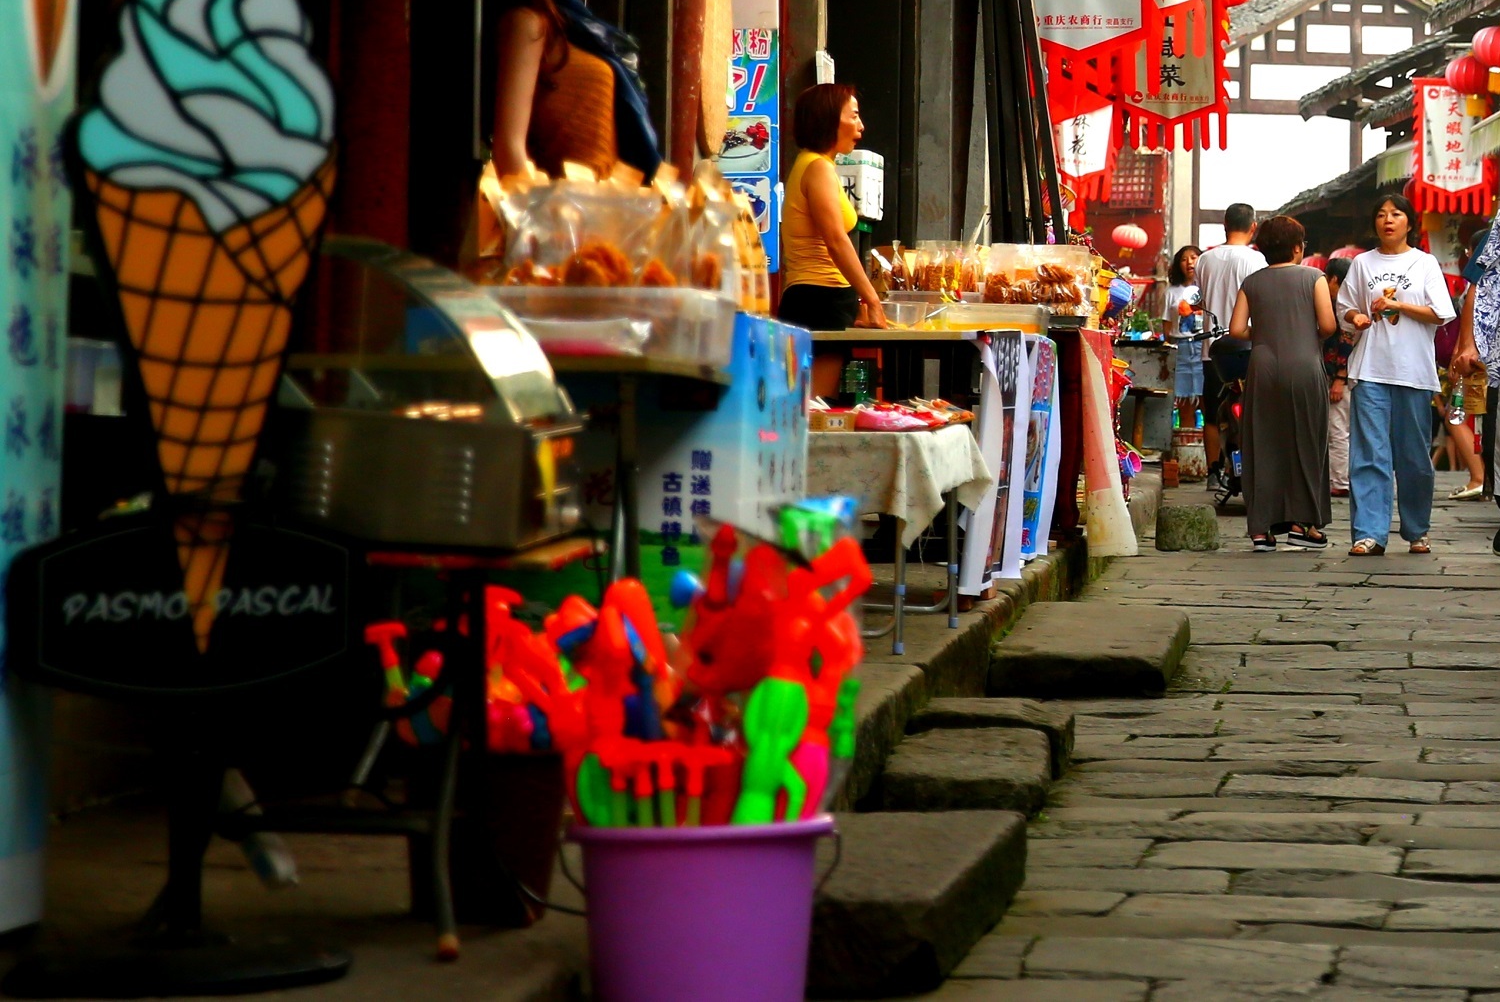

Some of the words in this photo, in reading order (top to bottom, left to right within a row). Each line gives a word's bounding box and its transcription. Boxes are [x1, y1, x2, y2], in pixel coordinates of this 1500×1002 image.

[1043, 14, 1103, 26] 重庆农商行
[1105, 17, 1134, 26] 荣昌支行
[1367, 272, 1396, 290] SINCE
[690, 450, 713, 545] 赠送佳
